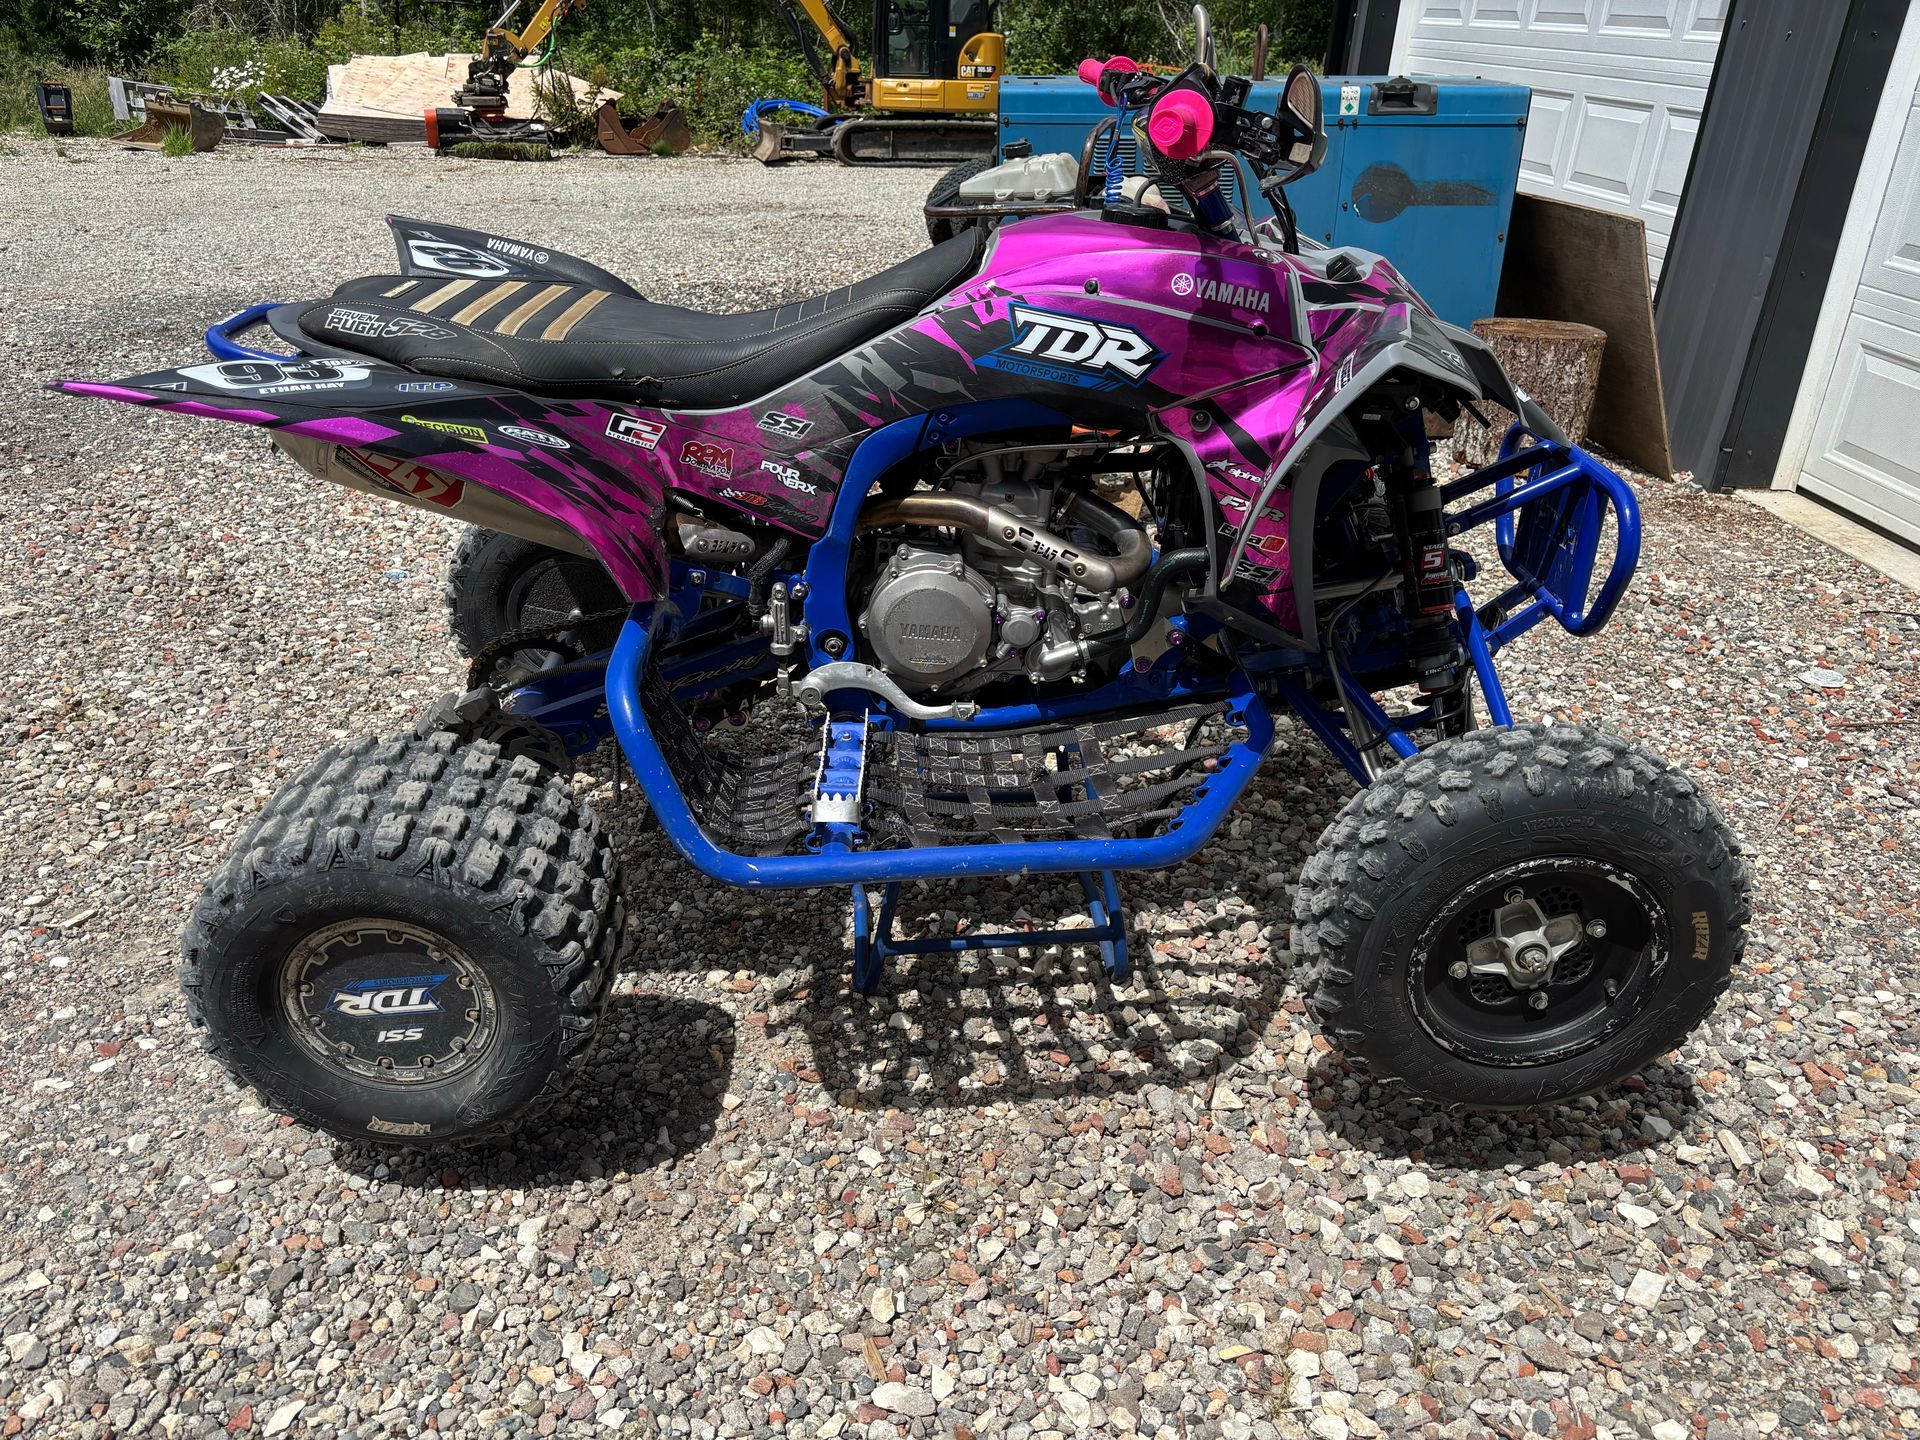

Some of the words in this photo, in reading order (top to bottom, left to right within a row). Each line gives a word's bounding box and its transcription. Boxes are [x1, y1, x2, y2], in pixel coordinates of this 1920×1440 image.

[961, 65, 976, 77] CAT
[487, 237, 534, 261] YAMAHA
[1196, 277, 1270, 313] YAMAHA
[324, 314, 386, 337] PUGH
[1010, 306, 1153, 379] TDR
[215, 360, 344, 386] 93
[995, 359, 1081, 385] MOTORSPORTS
[259, 384, 312, 395] ETHAN
[398, 381, 454, 393] ITP
[760, 410, 813, 435] SSI
[760, 460, 800, 480] FOUR
[1423, 551, 1443, 569] 5
[900, 623, 961, 641] YAMAHA
[333, 986, 440, 1017] TDR
[377, 1027, 425, 1043] SSI
